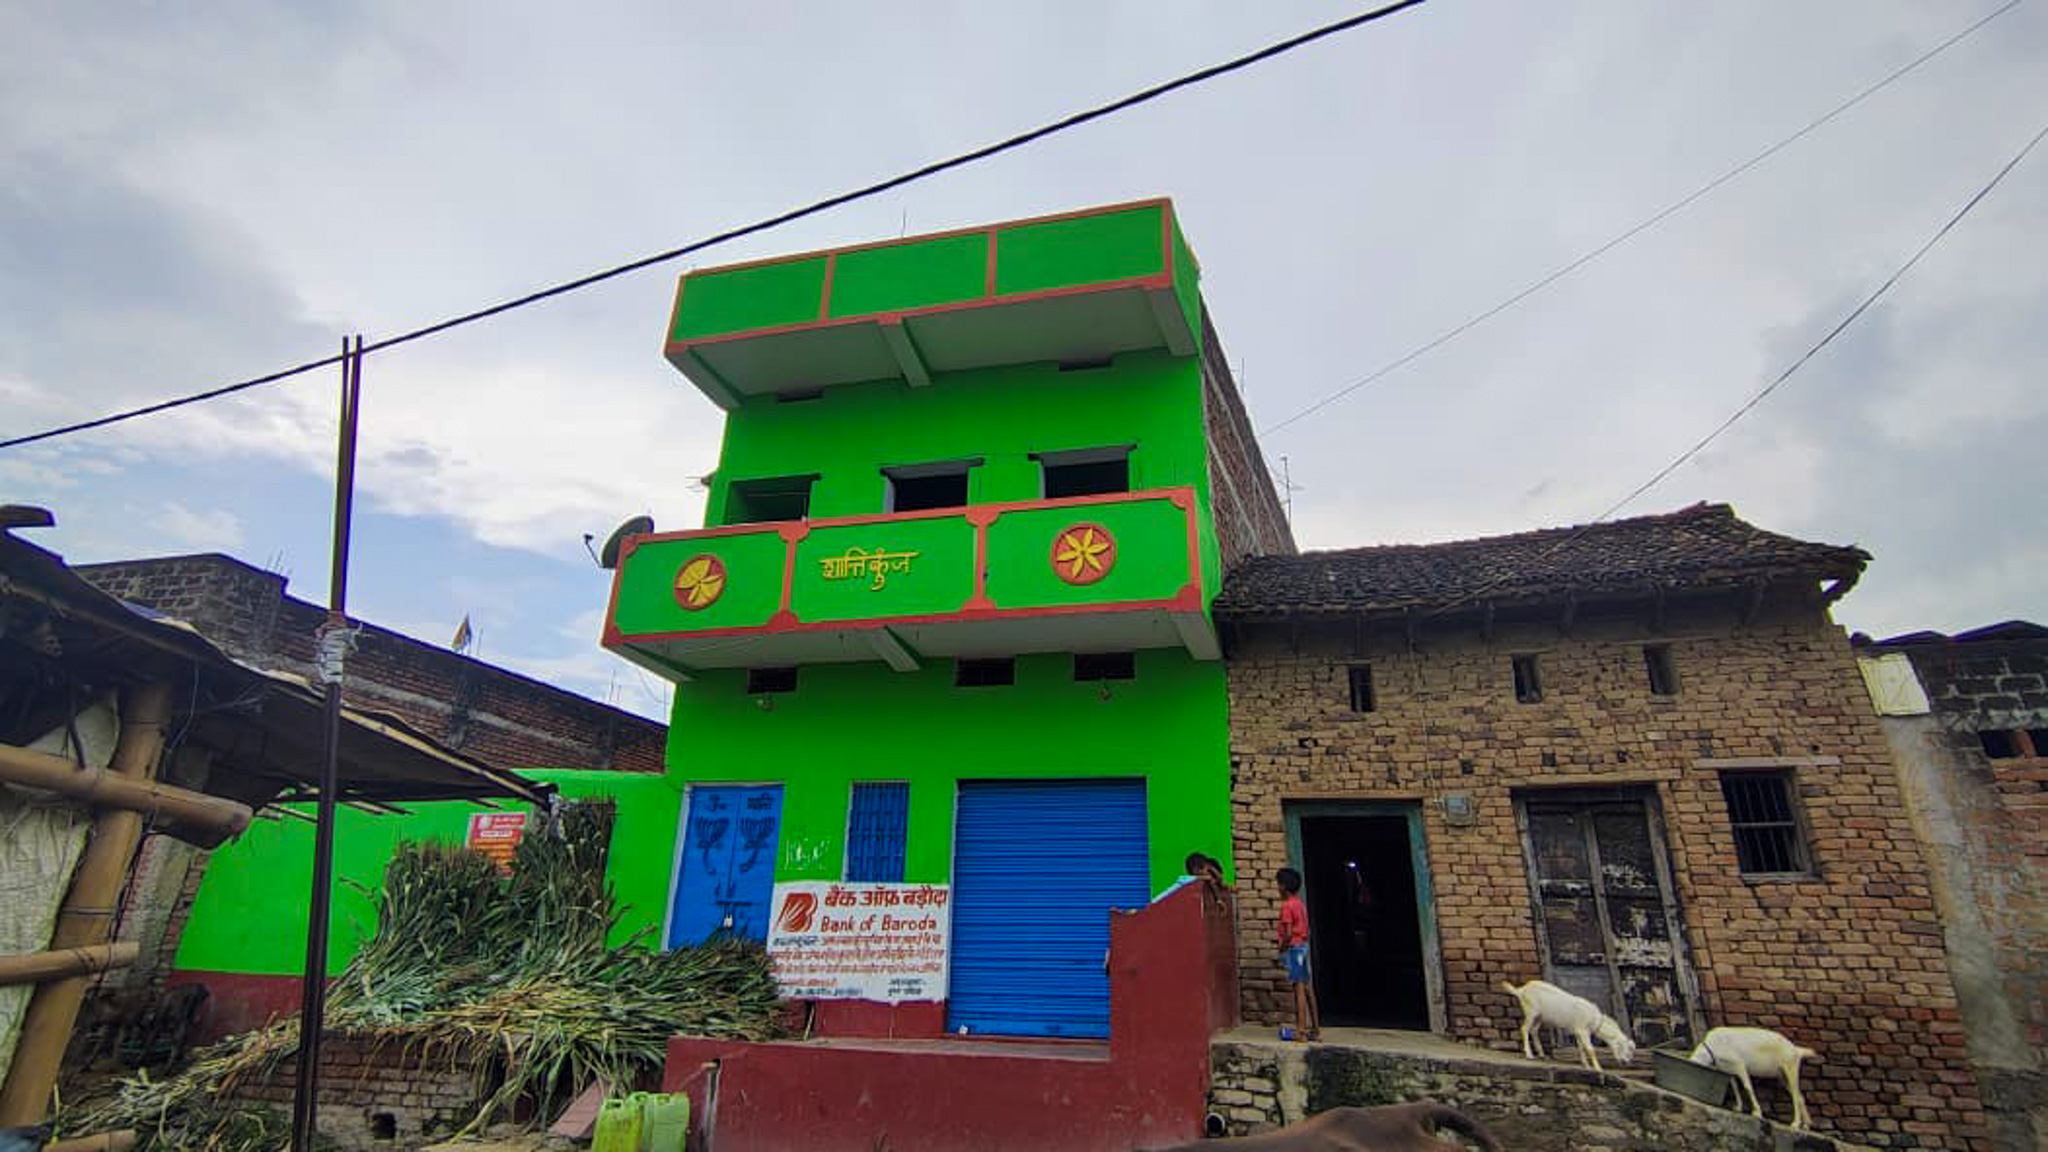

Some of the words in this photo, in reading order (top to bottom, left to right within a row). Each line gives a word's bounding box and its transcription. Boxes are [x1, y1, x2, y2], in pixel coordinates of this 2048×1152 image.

[820, 915, 854, 933] Bank
[860, 914, 877, 931] of
[881, 914, 937, 932] Baroda
